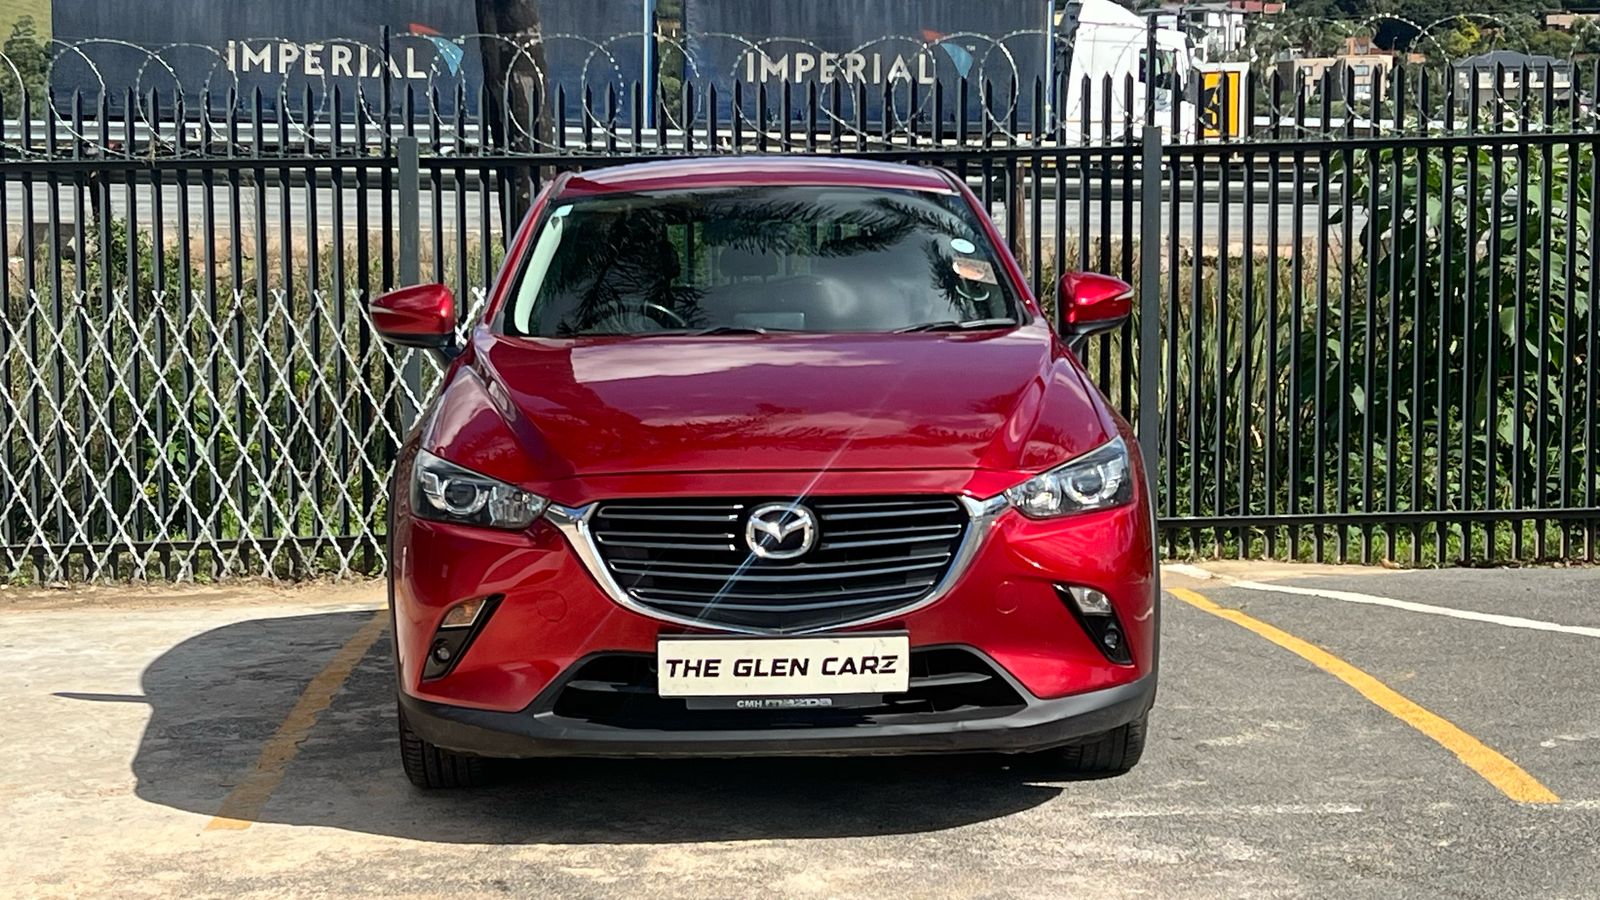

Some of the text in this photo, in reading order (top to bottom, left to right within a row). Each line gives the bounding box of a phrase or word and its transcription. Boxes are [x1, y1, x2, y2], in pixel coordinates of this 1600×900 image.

[228, 40, 428, 79] IMPERIAL
[746, 52, 935, 85] IMPERIAL
[666, 655, 899, 678] THE GLEN CARZ
[737, 700, 763, 708] CMH
